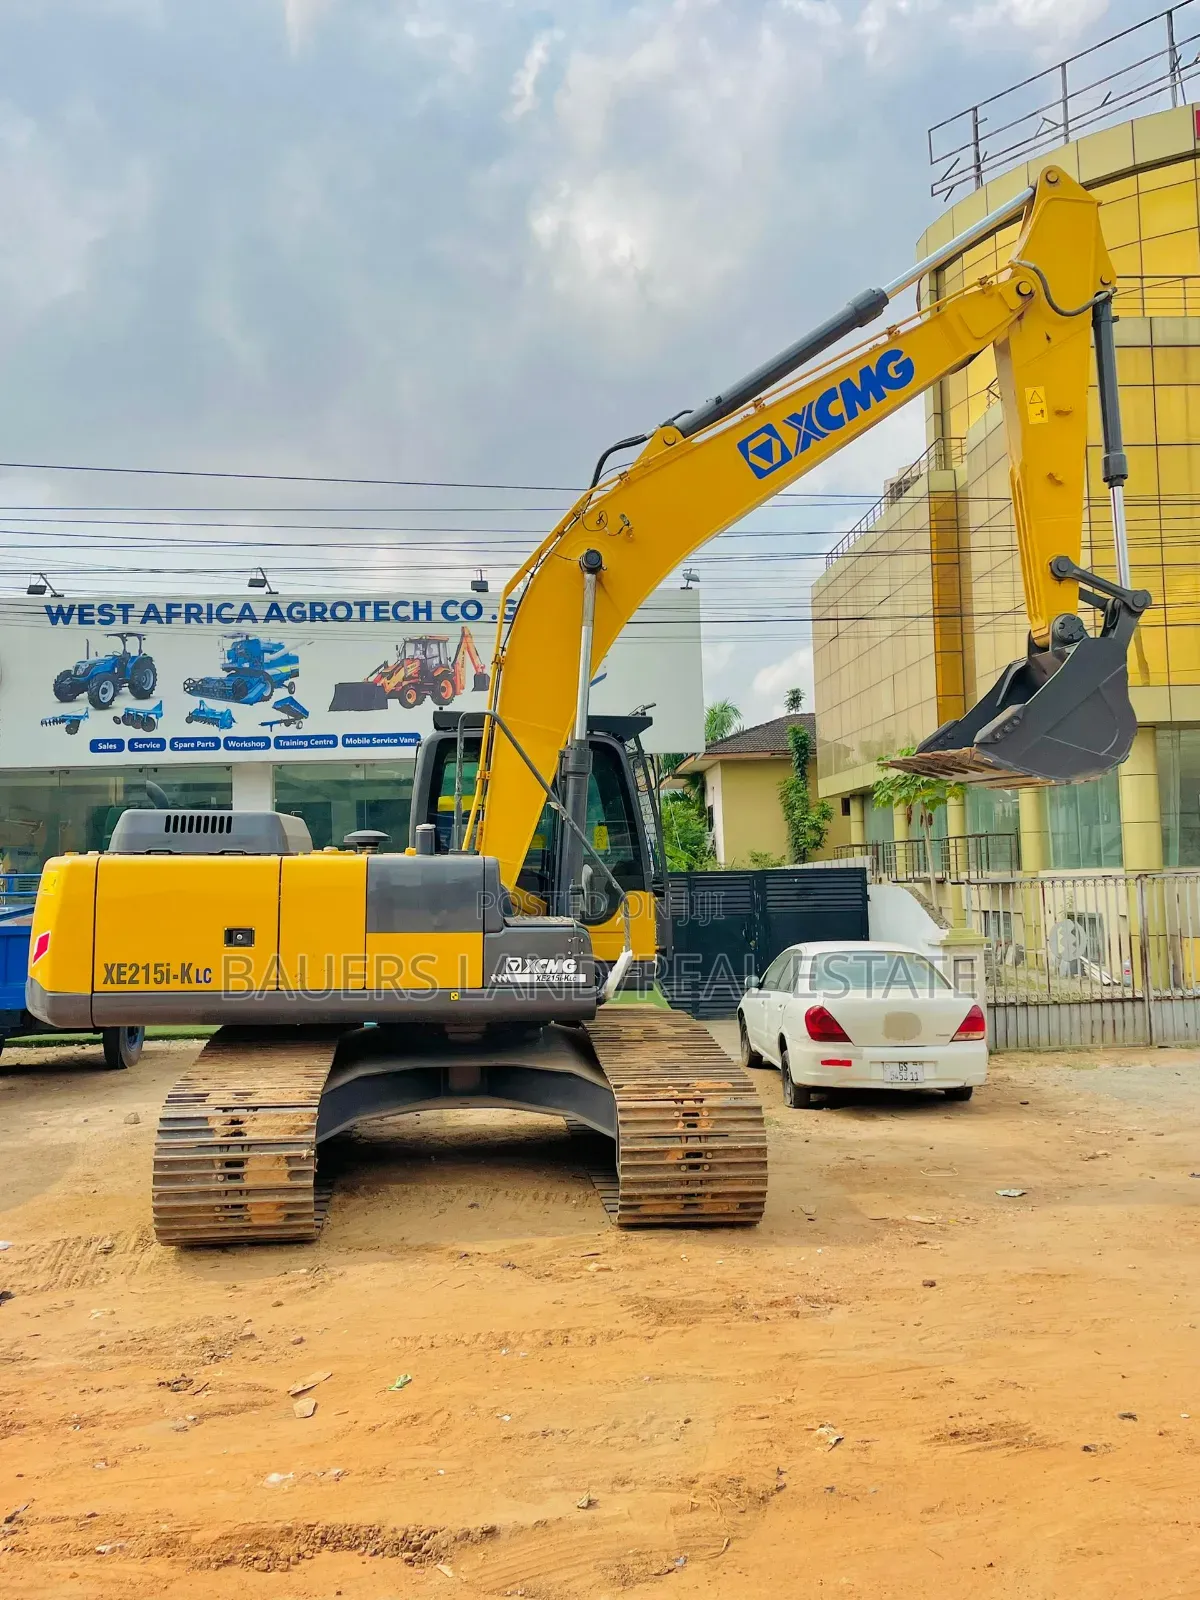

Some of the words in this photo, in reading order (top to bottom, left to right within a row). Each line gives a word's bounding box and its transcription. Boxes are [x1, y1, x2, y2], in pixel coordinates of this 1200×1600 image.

[782, 349, 915, 458] XCMG
[44, 603, 135, 625] WEST
[140, 602, 259, 625] AFRICA
[263, 600, 433, 624] AGROTECH
[134, 741, 161, 749] Service
[174, 741, 195, 749] Spare
[197, 740, 215, 748] Parts
[228, 739, 266, 749] Workshop
[279, 738, 308, 748] Training
[310, 738, 334, 746] Centre
[345, 736, 370, 745] Mobile
[372, 736, 398, 744] Service
[97, 742, 117, 750] Sales
[522, 958, 577, 974] XCMG
